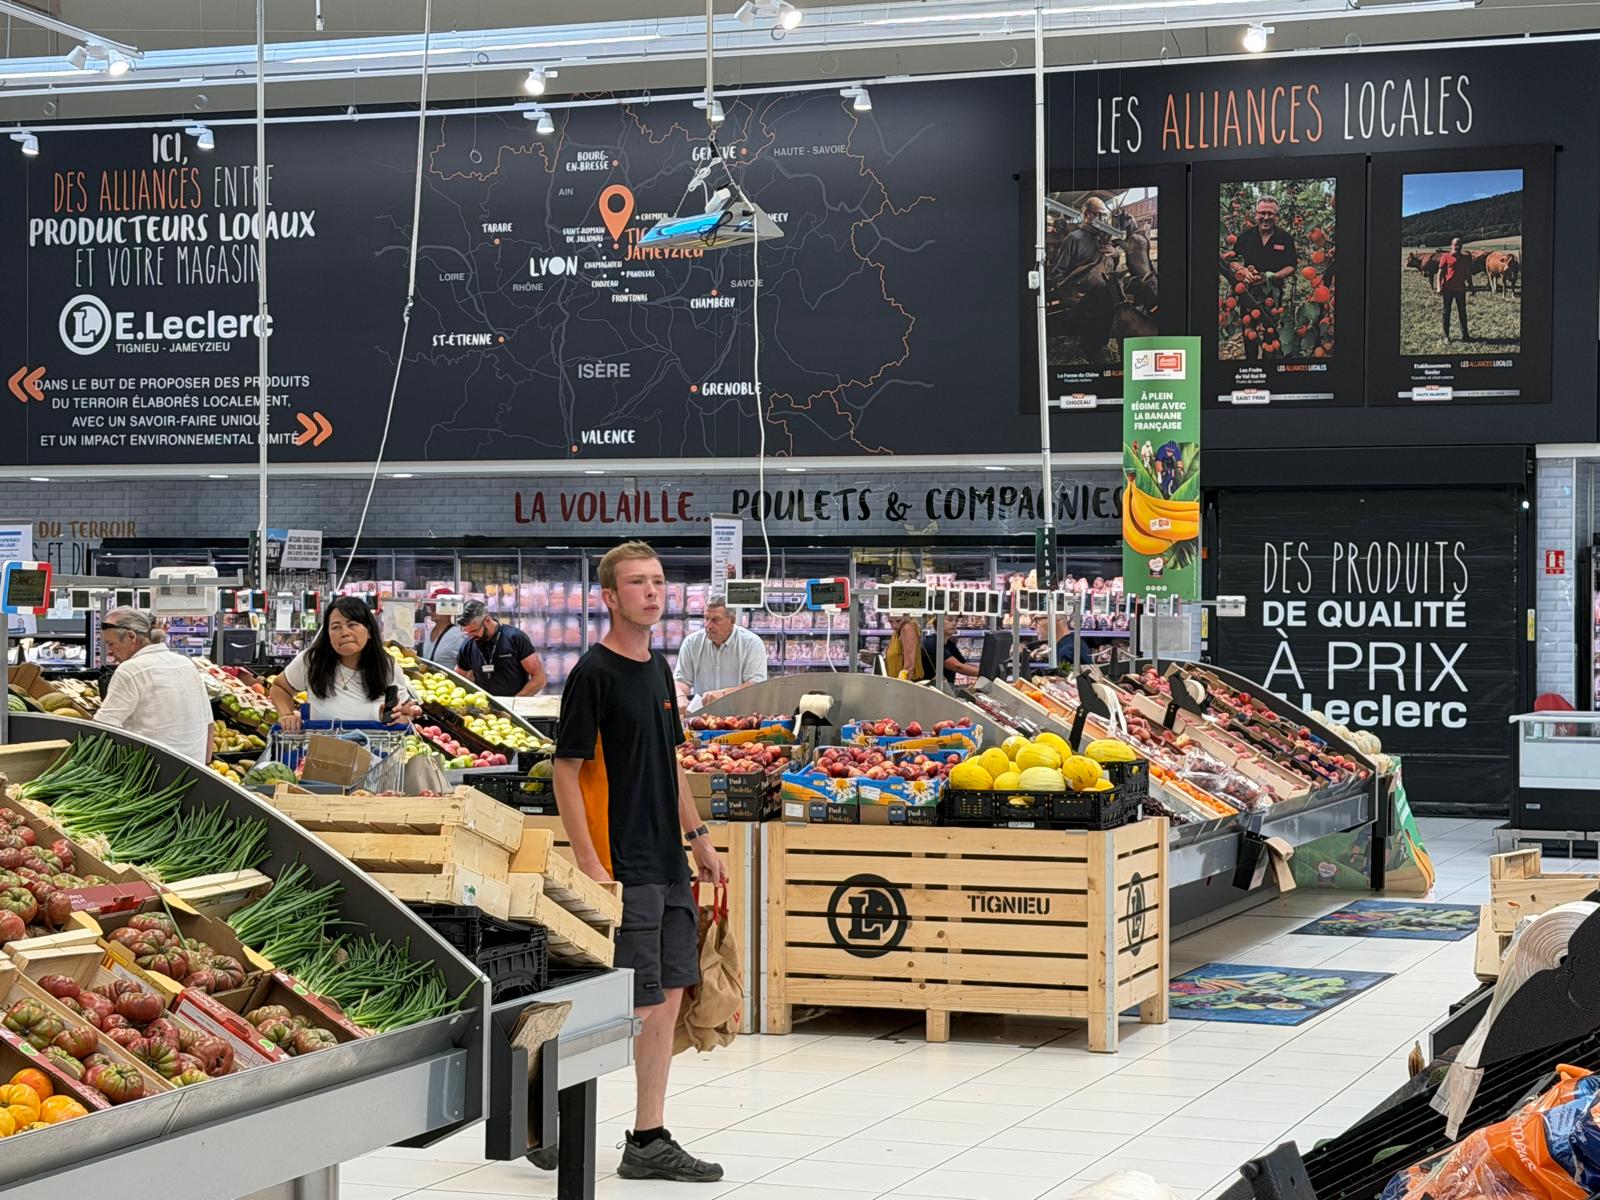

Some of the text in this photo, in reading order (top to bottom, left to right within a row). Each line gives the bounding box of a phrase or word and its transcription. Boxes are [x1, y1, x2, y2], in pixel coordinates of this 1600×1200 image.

[1096, 75, 1473, 154] LES ALLIANCES LOCALES
[152, 132, 188, 166] ICI,
[577, 151, 609, 161] BOURG-
[692, 146, 737, 161] GENVE
[773, 147, 806, 157] HAUTE
[812, 145, 847, 155] SAVOIE
[566, 161, 609, 172] EN-BRESSE
[54, 164, 274, 213] DES ALLIANCES ENTRE
[558, 188, 574, 197] AIN
[768, 212, 789, 222] NECY
[29, 209, 316, 247] PRODUCTEURS LOCAUX
[482, 222, 513, 233] TARARE
[75, 243, 261, 288] ET VOTRE MAGASIN
[529, 255, 578, 278] LYON
[439, 273, 466, 282] LOIRE
[626, 270, 655, 278] PANOSSAS
[512, 282, 544, 292] RHÔNE
[730, 279, 764, 288] SAVOIE
[690, 296, 736, 309] CHAMBÉRY
[116, 310, 273, 340] E.Leclerc
[432, 331, 493, 347] ST-ÉTIENNE
[116, 343, 160, 353] TIGNIEU
[169, 341, 231, 353] JAMEYZIEU
[578, 360, 631, 379] ISÈRE
[35, 379, 69, 391] DANS
[72, 379, 88, 390] LE
[91, 378, 116, 390] BUT
[119, 378, 136, 390] DE
[140, 377, 210, 389] PROPOSER
[214, 376, 240, 389] DES
[702, 381, 762, 397] GRENOBLE
[52, 393, 291, 409] DU TERROIR ÉLABORÉS LOCALEMENT,
[1148, 392, 1173, 400] PLEIN
[1131, 401, 1186, 411] RÉGIME AVEC
[72, 416, 104, 427] AVEC
[108, 416, 126, 427] UN
[130, 415, 217, 427] SAVOIR-FAIRE
[1134, 412, 1182, 421] LA BANANE
[1134, 422, 1182, 432] FRANÇAISE
[40, 435, 56, 446] ET
[60, 435, 77, 446] UN
[81, 434, 127, 446] IMPACT
[130, 433, 254, 446] ENVIRONNEMENTAL
[581, 429, 636, 445] VALENCE
[514, 491, 547, 523] LA
[733, 488, 872, 522] POULETS
[885, 490, 913, 521] &
[926, 484, 1123, 522] COMPAGNIES
[38, 520, 137, 538] DU TERROIR
[1263, 541, 1469, 594] DES PRODUITS
[1263, 594, 1467, 628] DE QUALITÉ
[1262, 628, 1469, 692] À PRIX
[967, 894, 1050, 916] TIGNIEU
